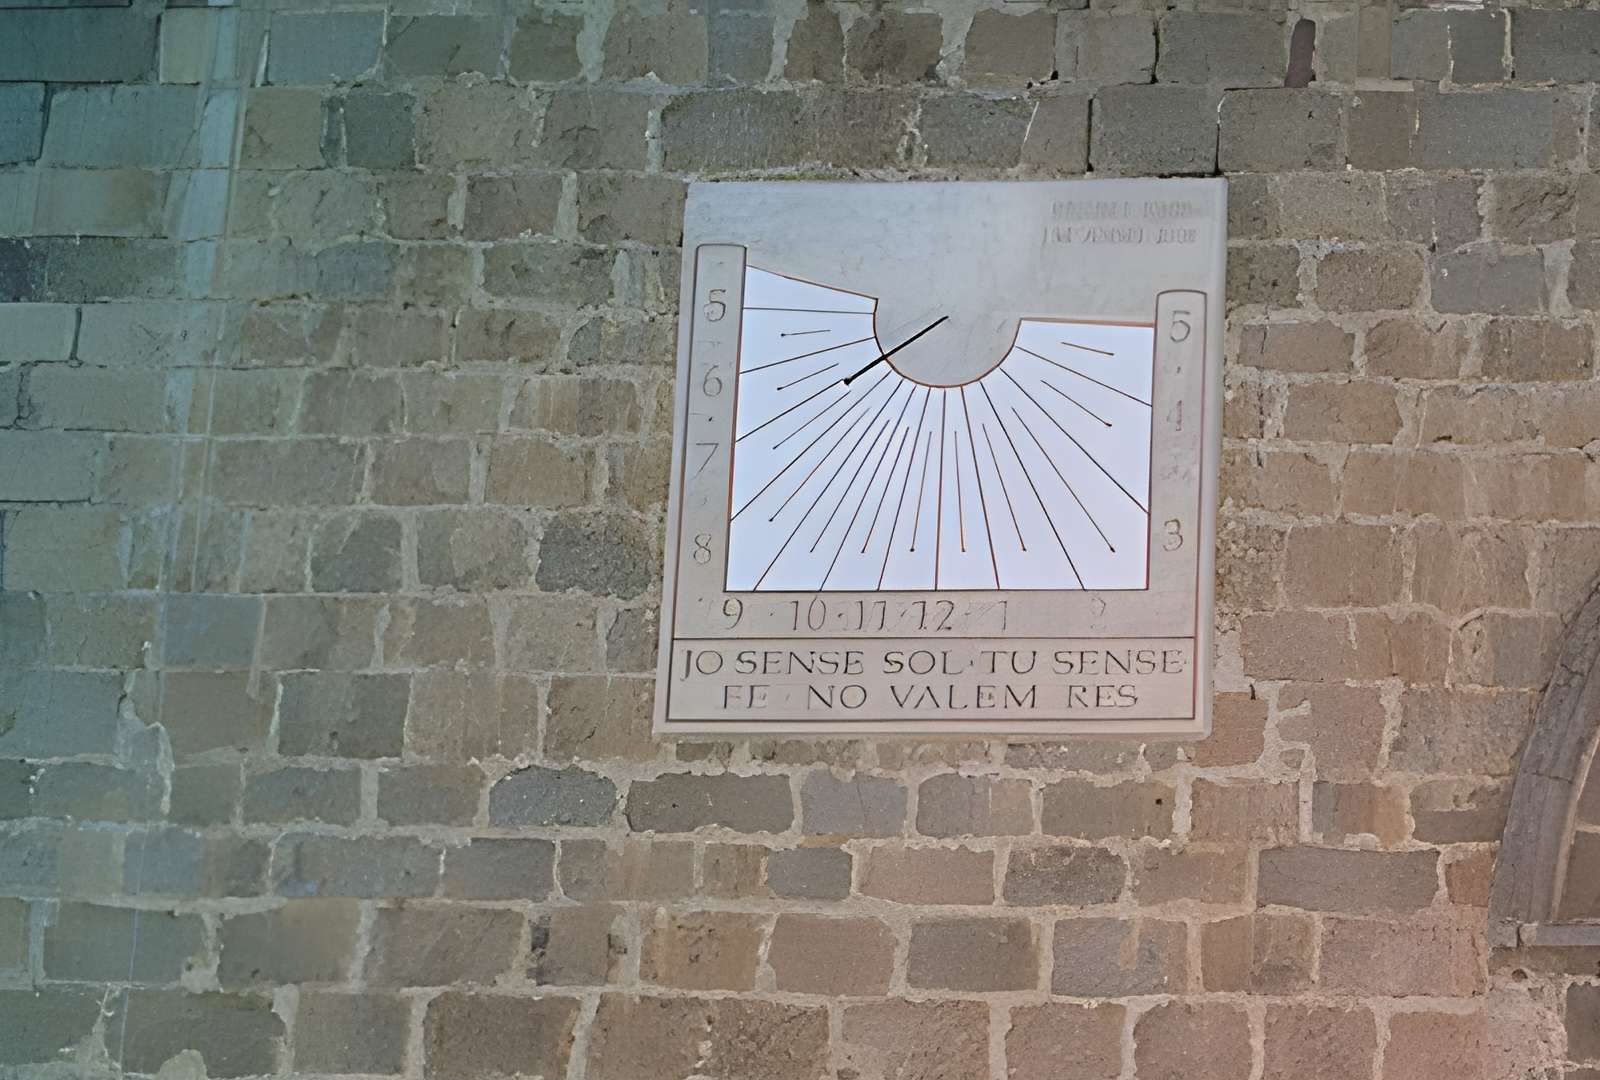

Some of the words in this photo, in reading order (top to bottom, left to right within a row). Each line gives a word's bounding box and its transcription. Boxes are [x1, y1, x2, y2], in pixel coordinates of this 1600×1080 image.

[704, 288, 727, 322] 5
[1169, 309, 1192, 343] 5
[702, 364, 723, 398] 6
[693, 442, 720, 481] 7
[693, 532, 712, 565] 8
[1162, 518, 1184, 552] 3
[722, 597, 744, 631] 9
[790, 596, 827, 632] 10
[855, 599, 887, 632] 11
[911, 599, 955, 632] 12
[679, 649, 724, 682] JO
[734, 650, 865, 675] SENSE
[1052, 650, 1184, 675] SENSE
[722, 684, 771, 710] FE
[807, 684, 868, 710] NO
[890, 683, 1038, 710] VALEM
[1066, 683, 1139, 709] RES
